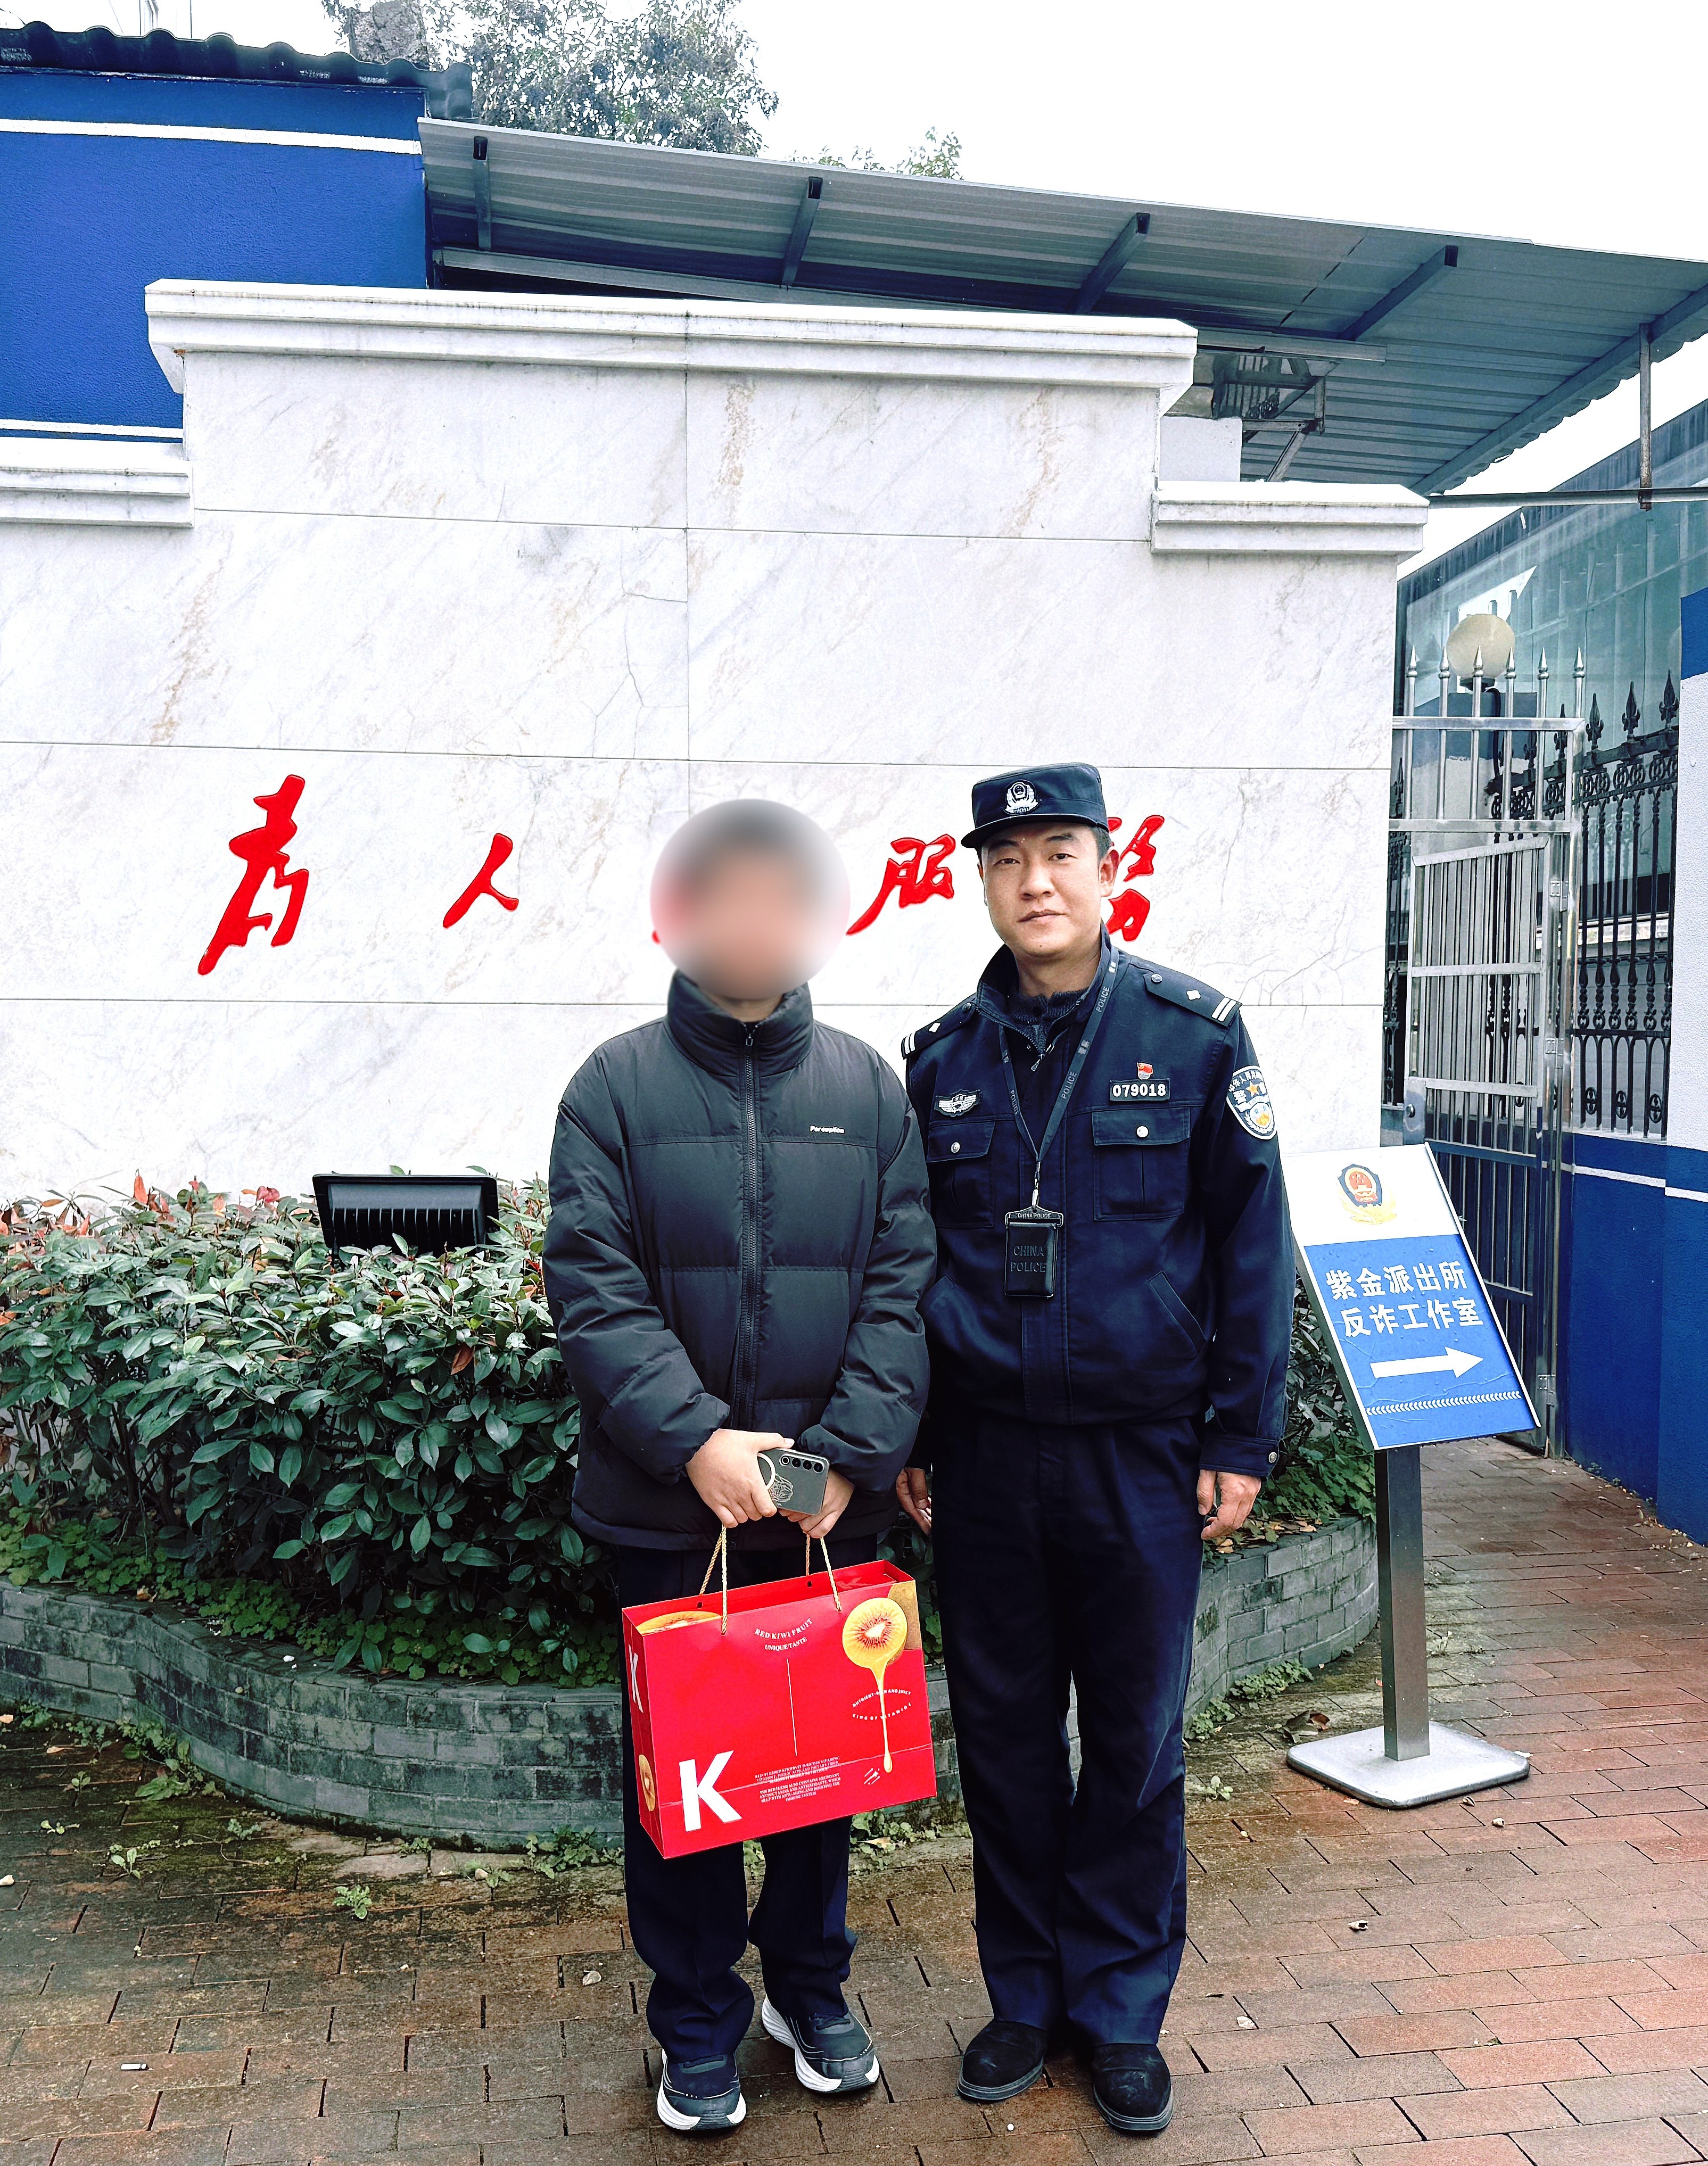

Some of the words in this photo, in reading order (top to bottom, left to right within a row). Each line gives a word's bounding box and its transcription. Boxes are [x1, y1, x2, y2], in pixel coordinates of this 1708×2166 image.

[1096, 986, 1110, 1012] POLICE
[1061, 1071, 1077, 1099] POLICE
[1112, 1084, 1166, 1097] 079018
[810, 1125, 845, 1134] Perception
[1013, 1245, 1044, 1256] CHINA
[1011, 1262, 1046, 1272] POLICE
[1326, 1260, 1469, 1301] 紫金派出所
[1340, 1297, 1484, 1338] 反诈工作室
[755, 1628, 770, 1638] RED
[791, 1618, 812, 1636] FRUIT
[788, 1636, 807, 1649] TASTE
[679, 1750, 742, 1832] K
